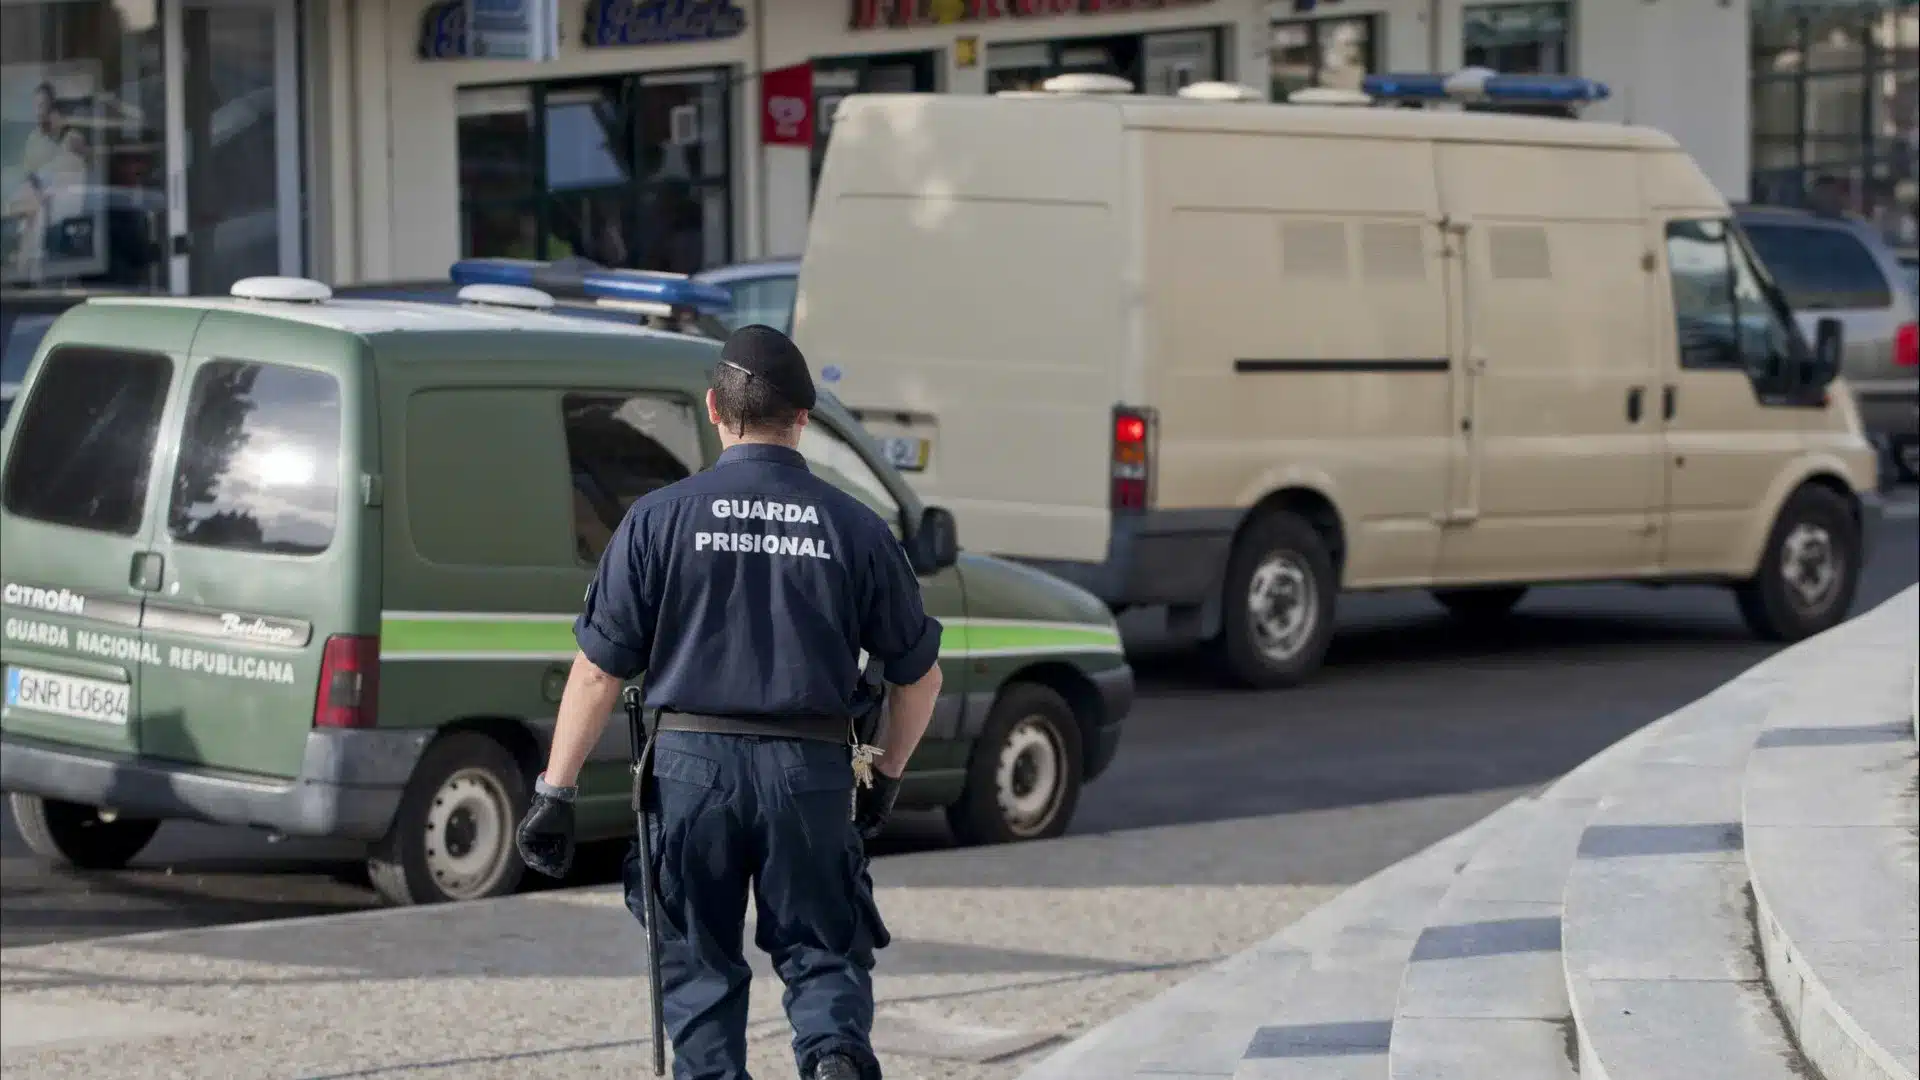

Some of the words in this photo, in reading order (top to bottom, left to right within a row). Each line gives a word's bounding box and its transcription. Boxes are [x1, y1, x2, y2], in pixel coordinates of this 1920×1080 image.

[712, 499, 819, 524] GUARDA
[695, 532, 831, 559] PRISIONAL
[4, 583, 85, 614] CITROËN
[220, 612, 293, 642] Berlingo
[5, 617, 69, 648] GUARDA
[76, 630, 162, 665] NACIONAL
[168, 646, 294, 684] REPUBLICANA
[20, 676, 61, 707] GNR
